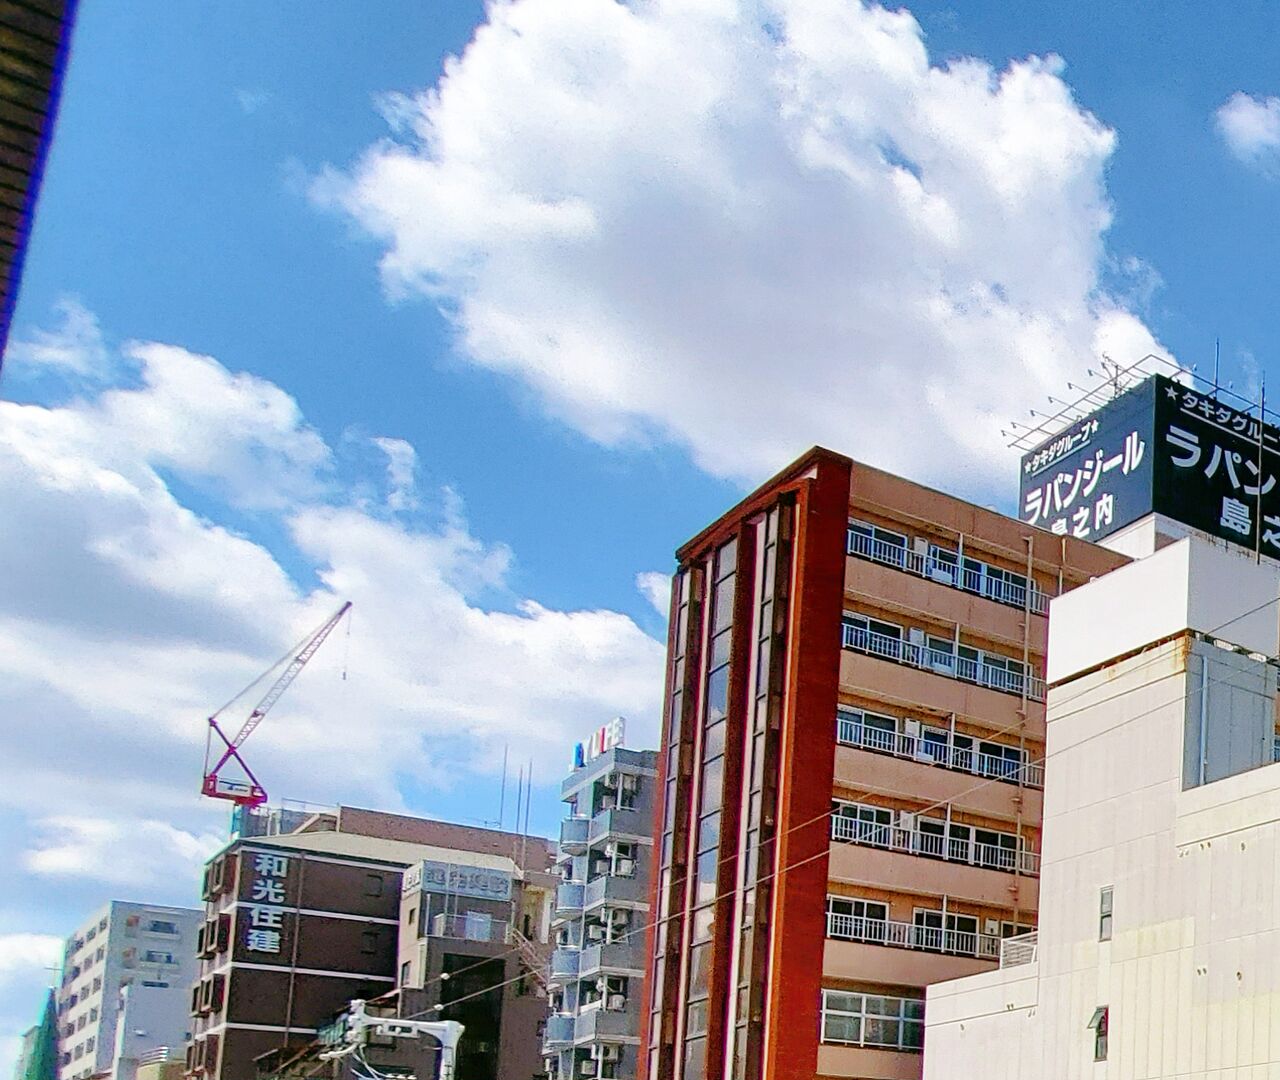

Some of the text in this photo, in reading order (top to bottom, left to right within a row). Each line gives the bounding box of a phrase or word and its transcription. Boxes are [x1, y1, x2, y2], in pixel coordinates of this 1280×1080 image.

[1024, 431, 1146, 525] ラパンジール
[247, 854, 289, 953] 和光住建
